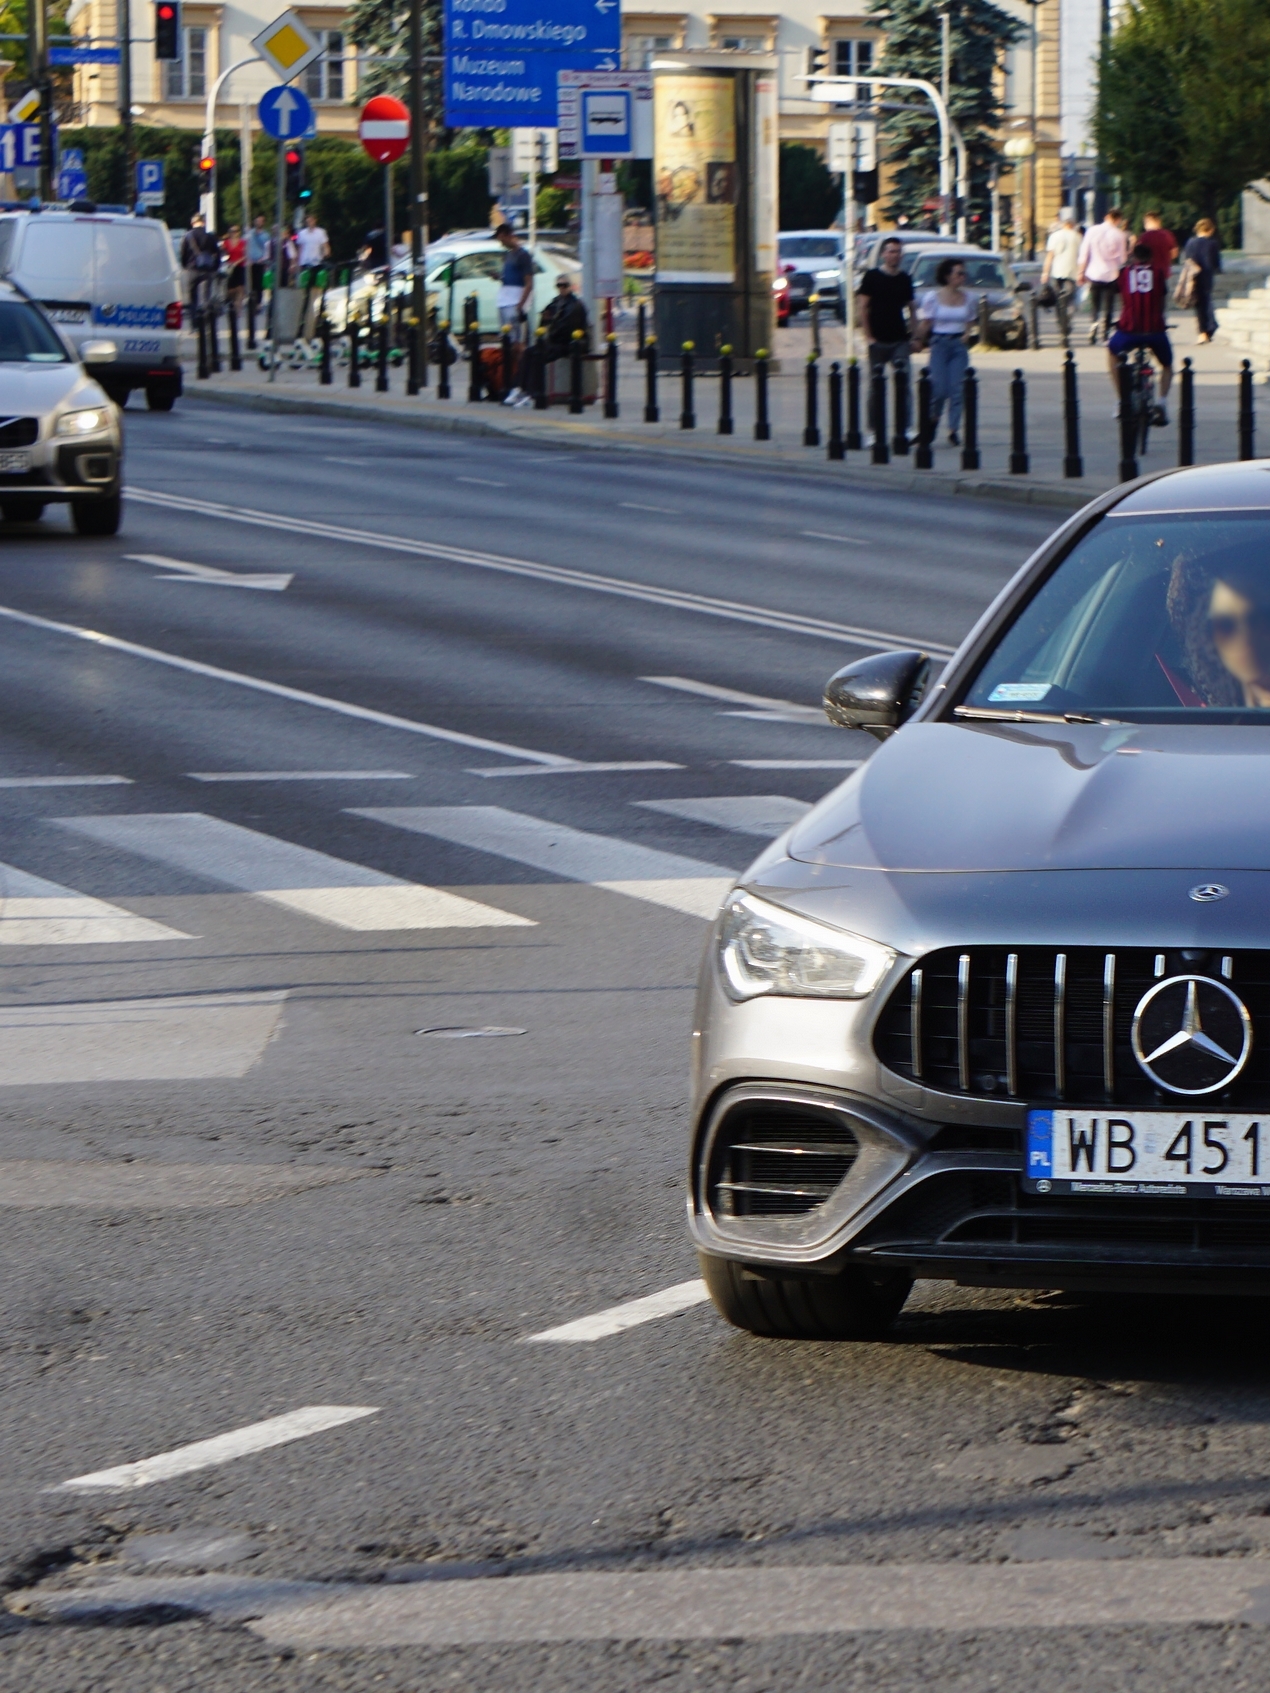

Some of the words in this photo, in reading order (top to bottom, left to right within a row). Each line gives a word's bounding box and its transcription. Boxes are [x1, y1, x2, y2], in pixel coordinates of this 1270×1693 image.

[452, 19, 469, 39] R.
[472, 19, 588, 46] Dmowskiego
[452, 55, 526, 75] Muzeum
[452, 81, 542, 102] Narodowe
[1129, 269, 1154, 294] 19
[117, 310, 162, 323] POLICJA
[1068, 1117, 1137, 1173] WB
[1030, 1151, 1051, 1167] PL
